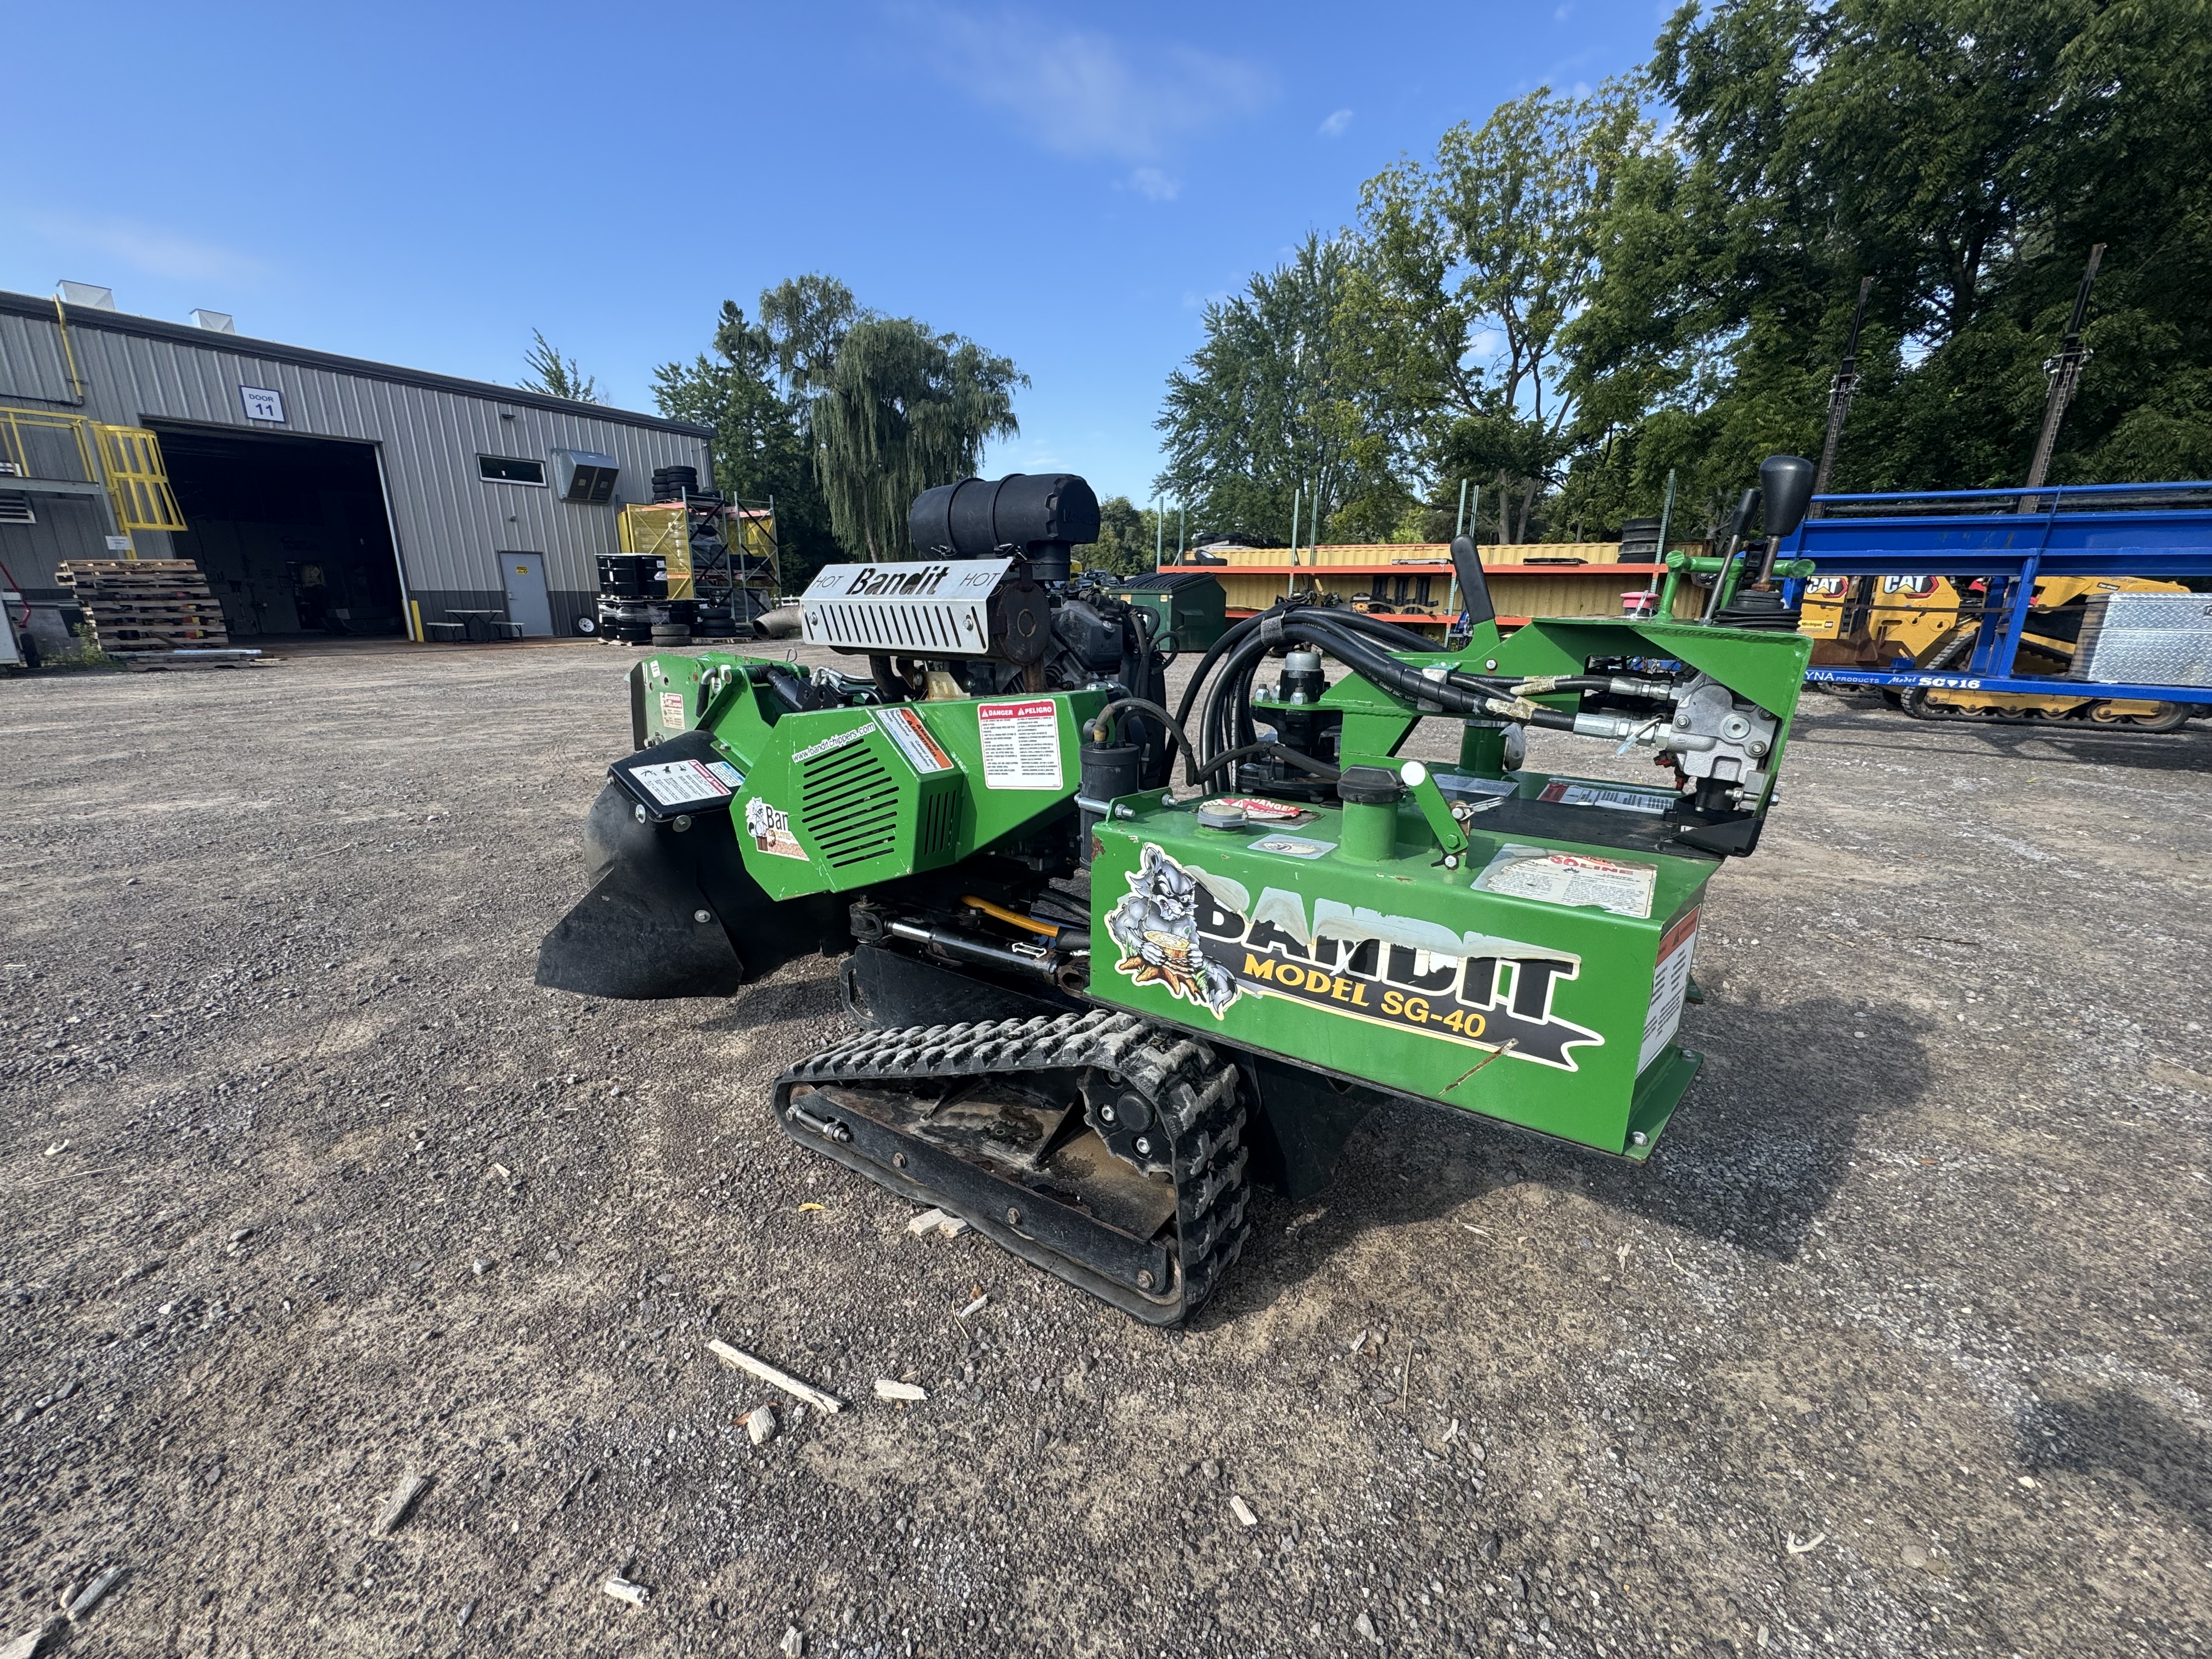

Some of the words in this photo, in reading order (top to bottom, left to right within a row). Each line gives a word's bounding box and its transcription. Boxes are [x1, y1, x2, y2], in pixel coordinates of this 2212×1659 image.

[249, 393, 274, 402] DOOR
[255, 403, 274, 416] 11
[811, 576, 844, 588] HOT
[845, 566, 950, 595] Bandit
[959, 572, 1001, 586] HOT
[1806, 577, 1841, 594] CAT
[1884, 576, 1928, 594] CAT
[1887, 676, 1917, 685] Model
[1025, 706, 1052, 714] PELIGRO
[889, 711, 910, 737] Reproductive
[792, 723, 876, 762] www.banditchippers.com
[911, 726, 937, 757] ADVERTENCIA
[921, 729, 939, 751] WARNING
[910, 741, 930, 767] reproductivo
[1251, 799, 1296, 811] DANGER
[1243, 953, 1370, 1007] MODEL
[1380, 990, 1487, 1037] SG-40
